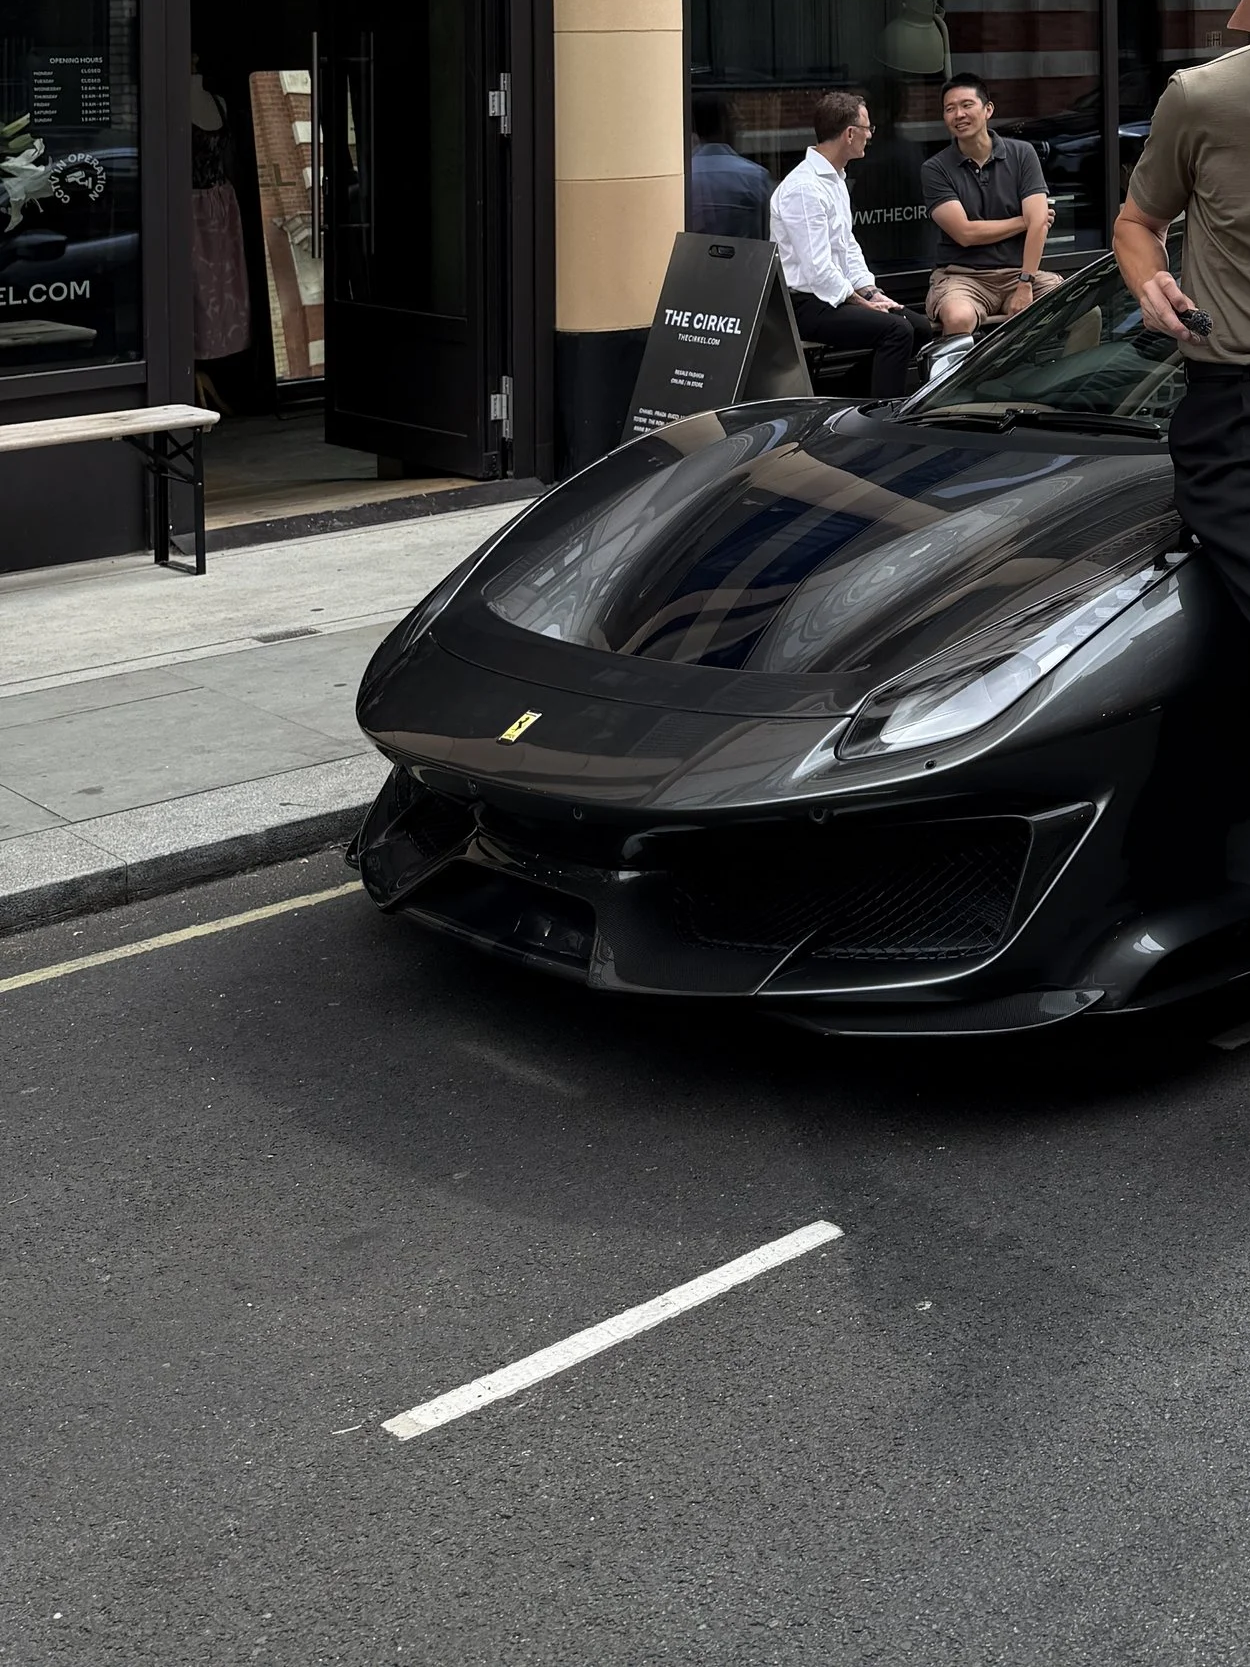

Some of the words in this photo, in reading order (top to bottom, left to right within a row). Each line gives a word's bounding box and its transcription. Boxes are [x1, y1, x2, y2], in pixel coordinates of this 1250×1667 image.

[49, 57, 79, 65] OPENING
[51, 158, 67, 175] IN
[67, 153, 107, 202] OPERATION
[48, 178, 70, 204] CCTV
[664, 309, 692, 328] THE
[693, 313, 742, 335] CIRKEL
[678, 333, 721, 346] THECIRKEL.COM
